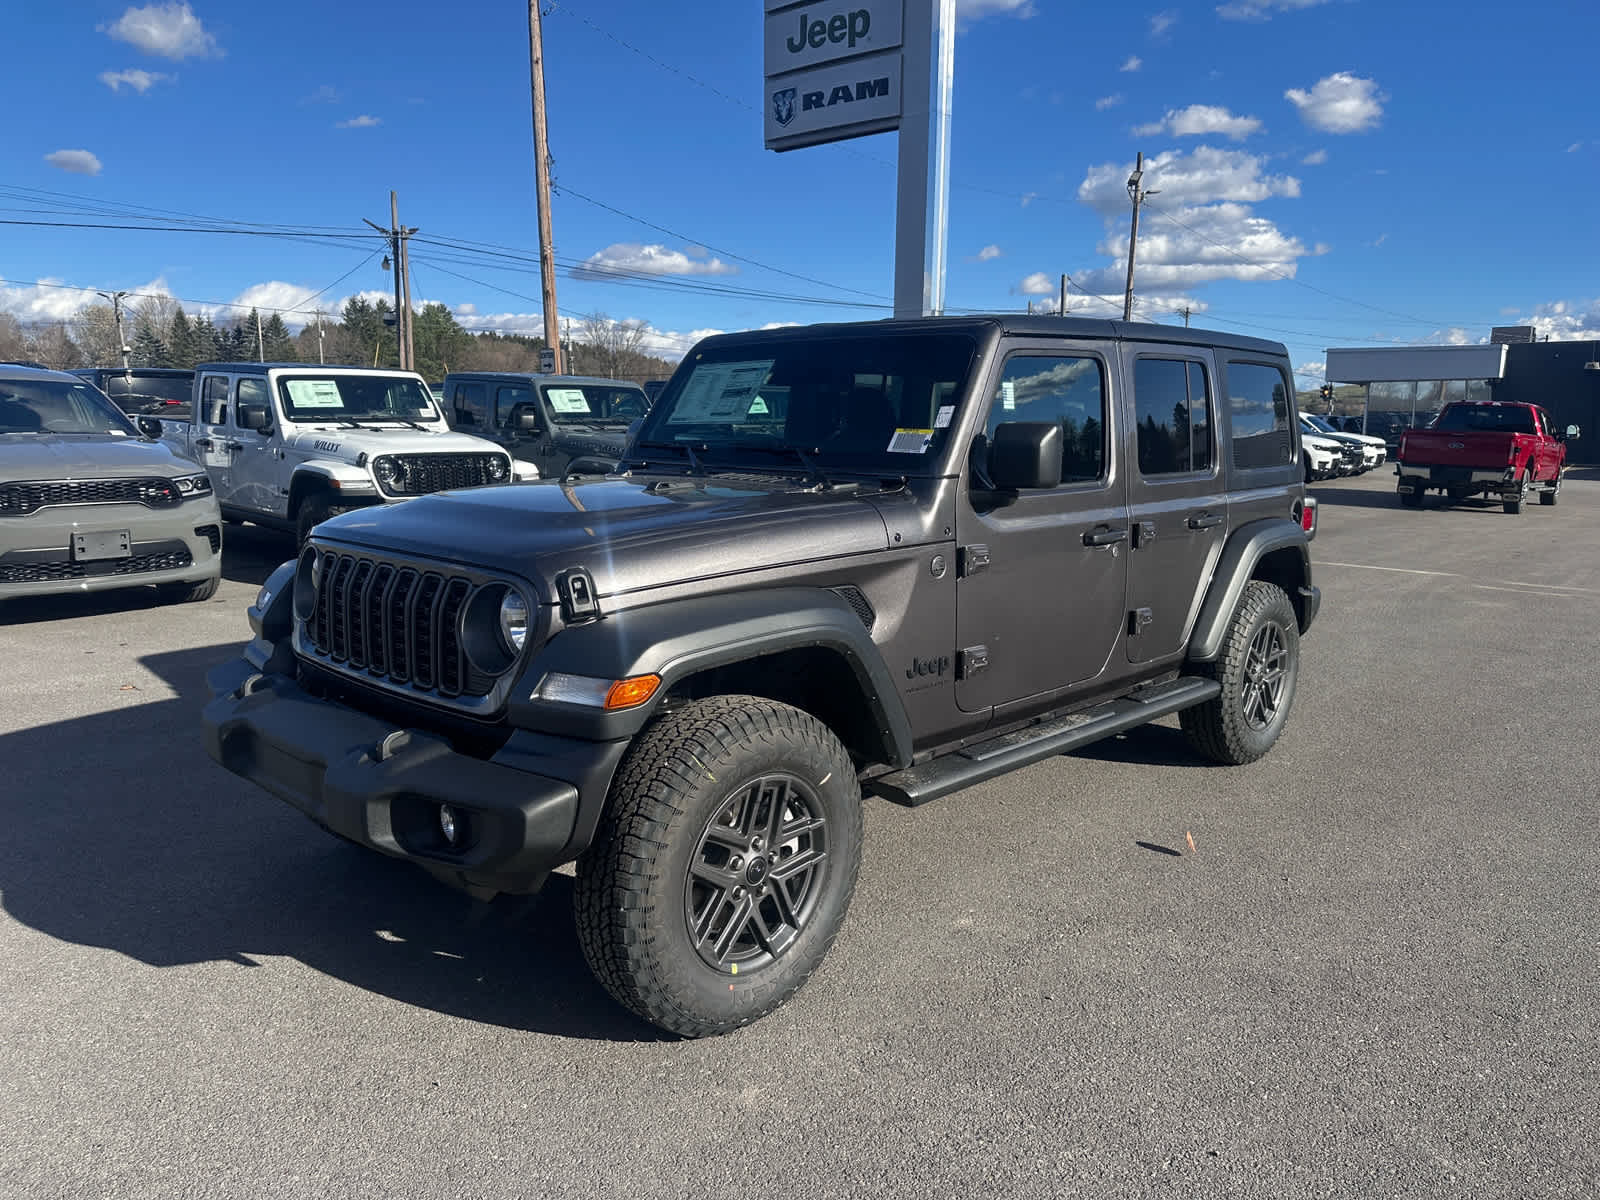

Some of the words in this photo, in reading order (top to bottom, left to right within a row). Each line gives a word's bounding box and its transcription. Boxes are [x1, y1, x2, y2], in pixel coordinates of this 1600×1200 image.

[786, 8, 871, 54] Jeep
[801, 77, 889, 112] RAM
[313, 440, 342, 453] WILLYS
[905, 656, 950, 680] Jeep
